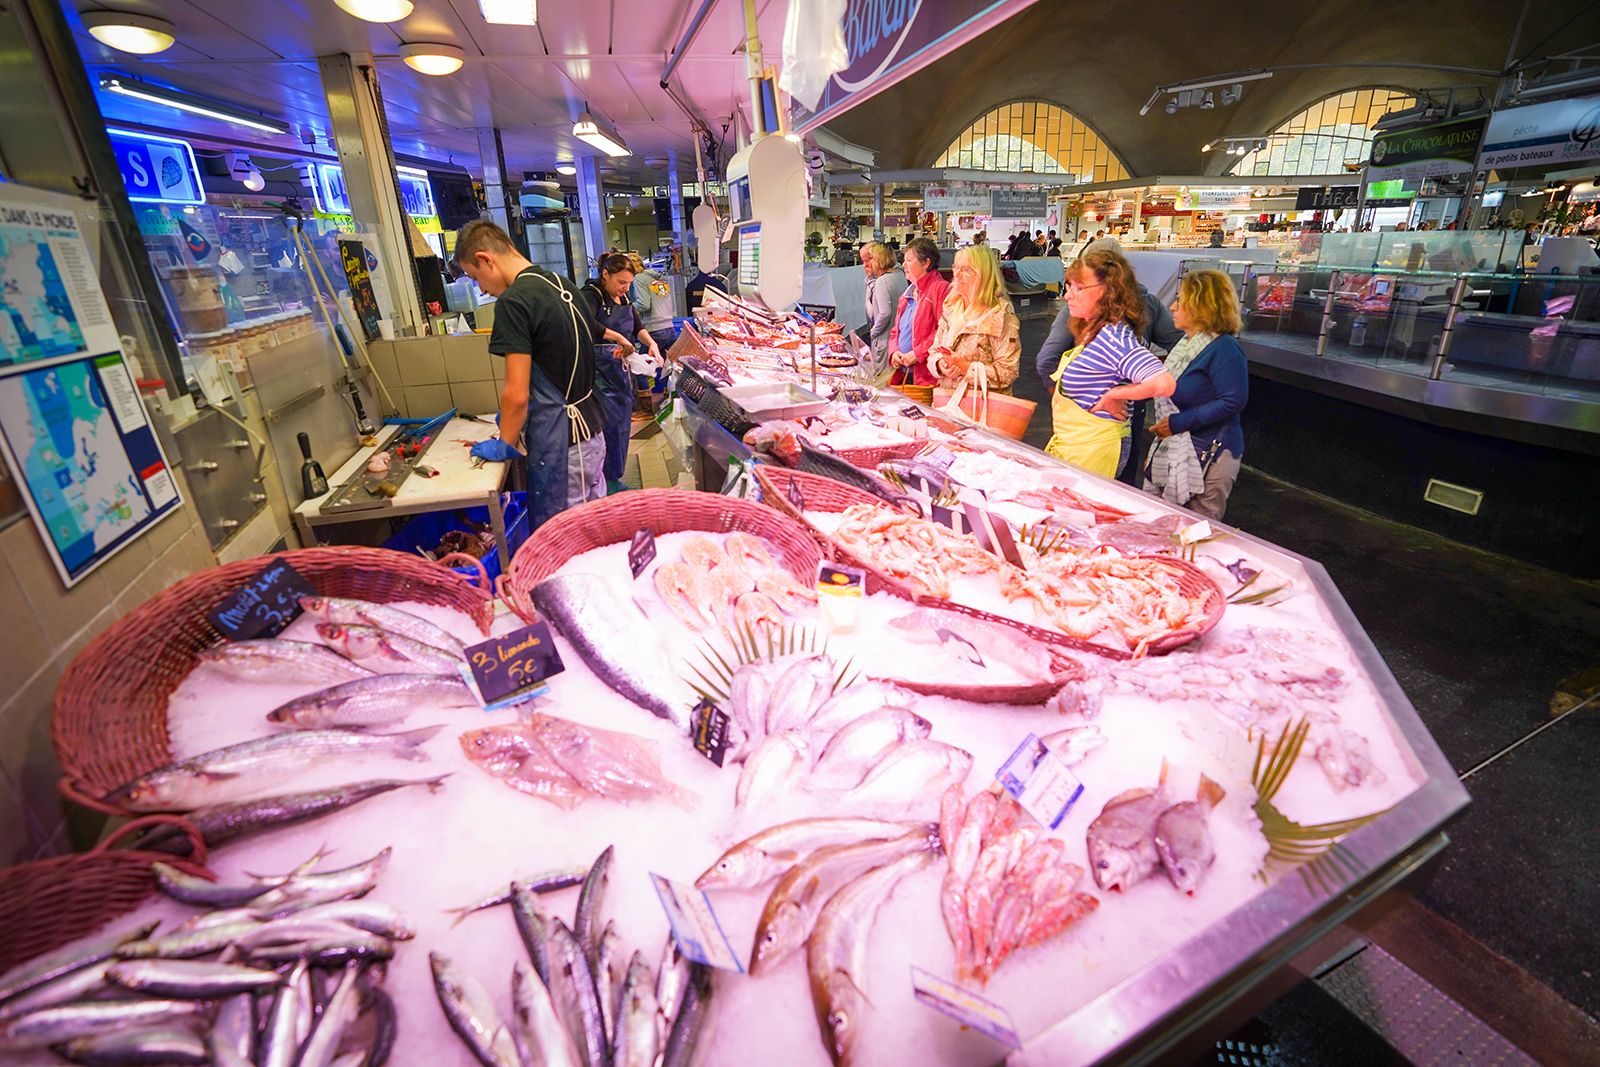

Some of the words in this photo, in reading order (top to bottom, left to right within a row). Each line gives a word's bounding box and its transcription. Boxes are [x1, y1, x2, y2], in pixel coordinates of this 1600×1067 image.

[1513, 124, 1539, 138] pêche
[1563, 142, 1580, 152] les
[1485, 156, 1495, 165] de
[1495, 153, 1518, 165] petits
[1520, 150, 1555, 161] bateaux
